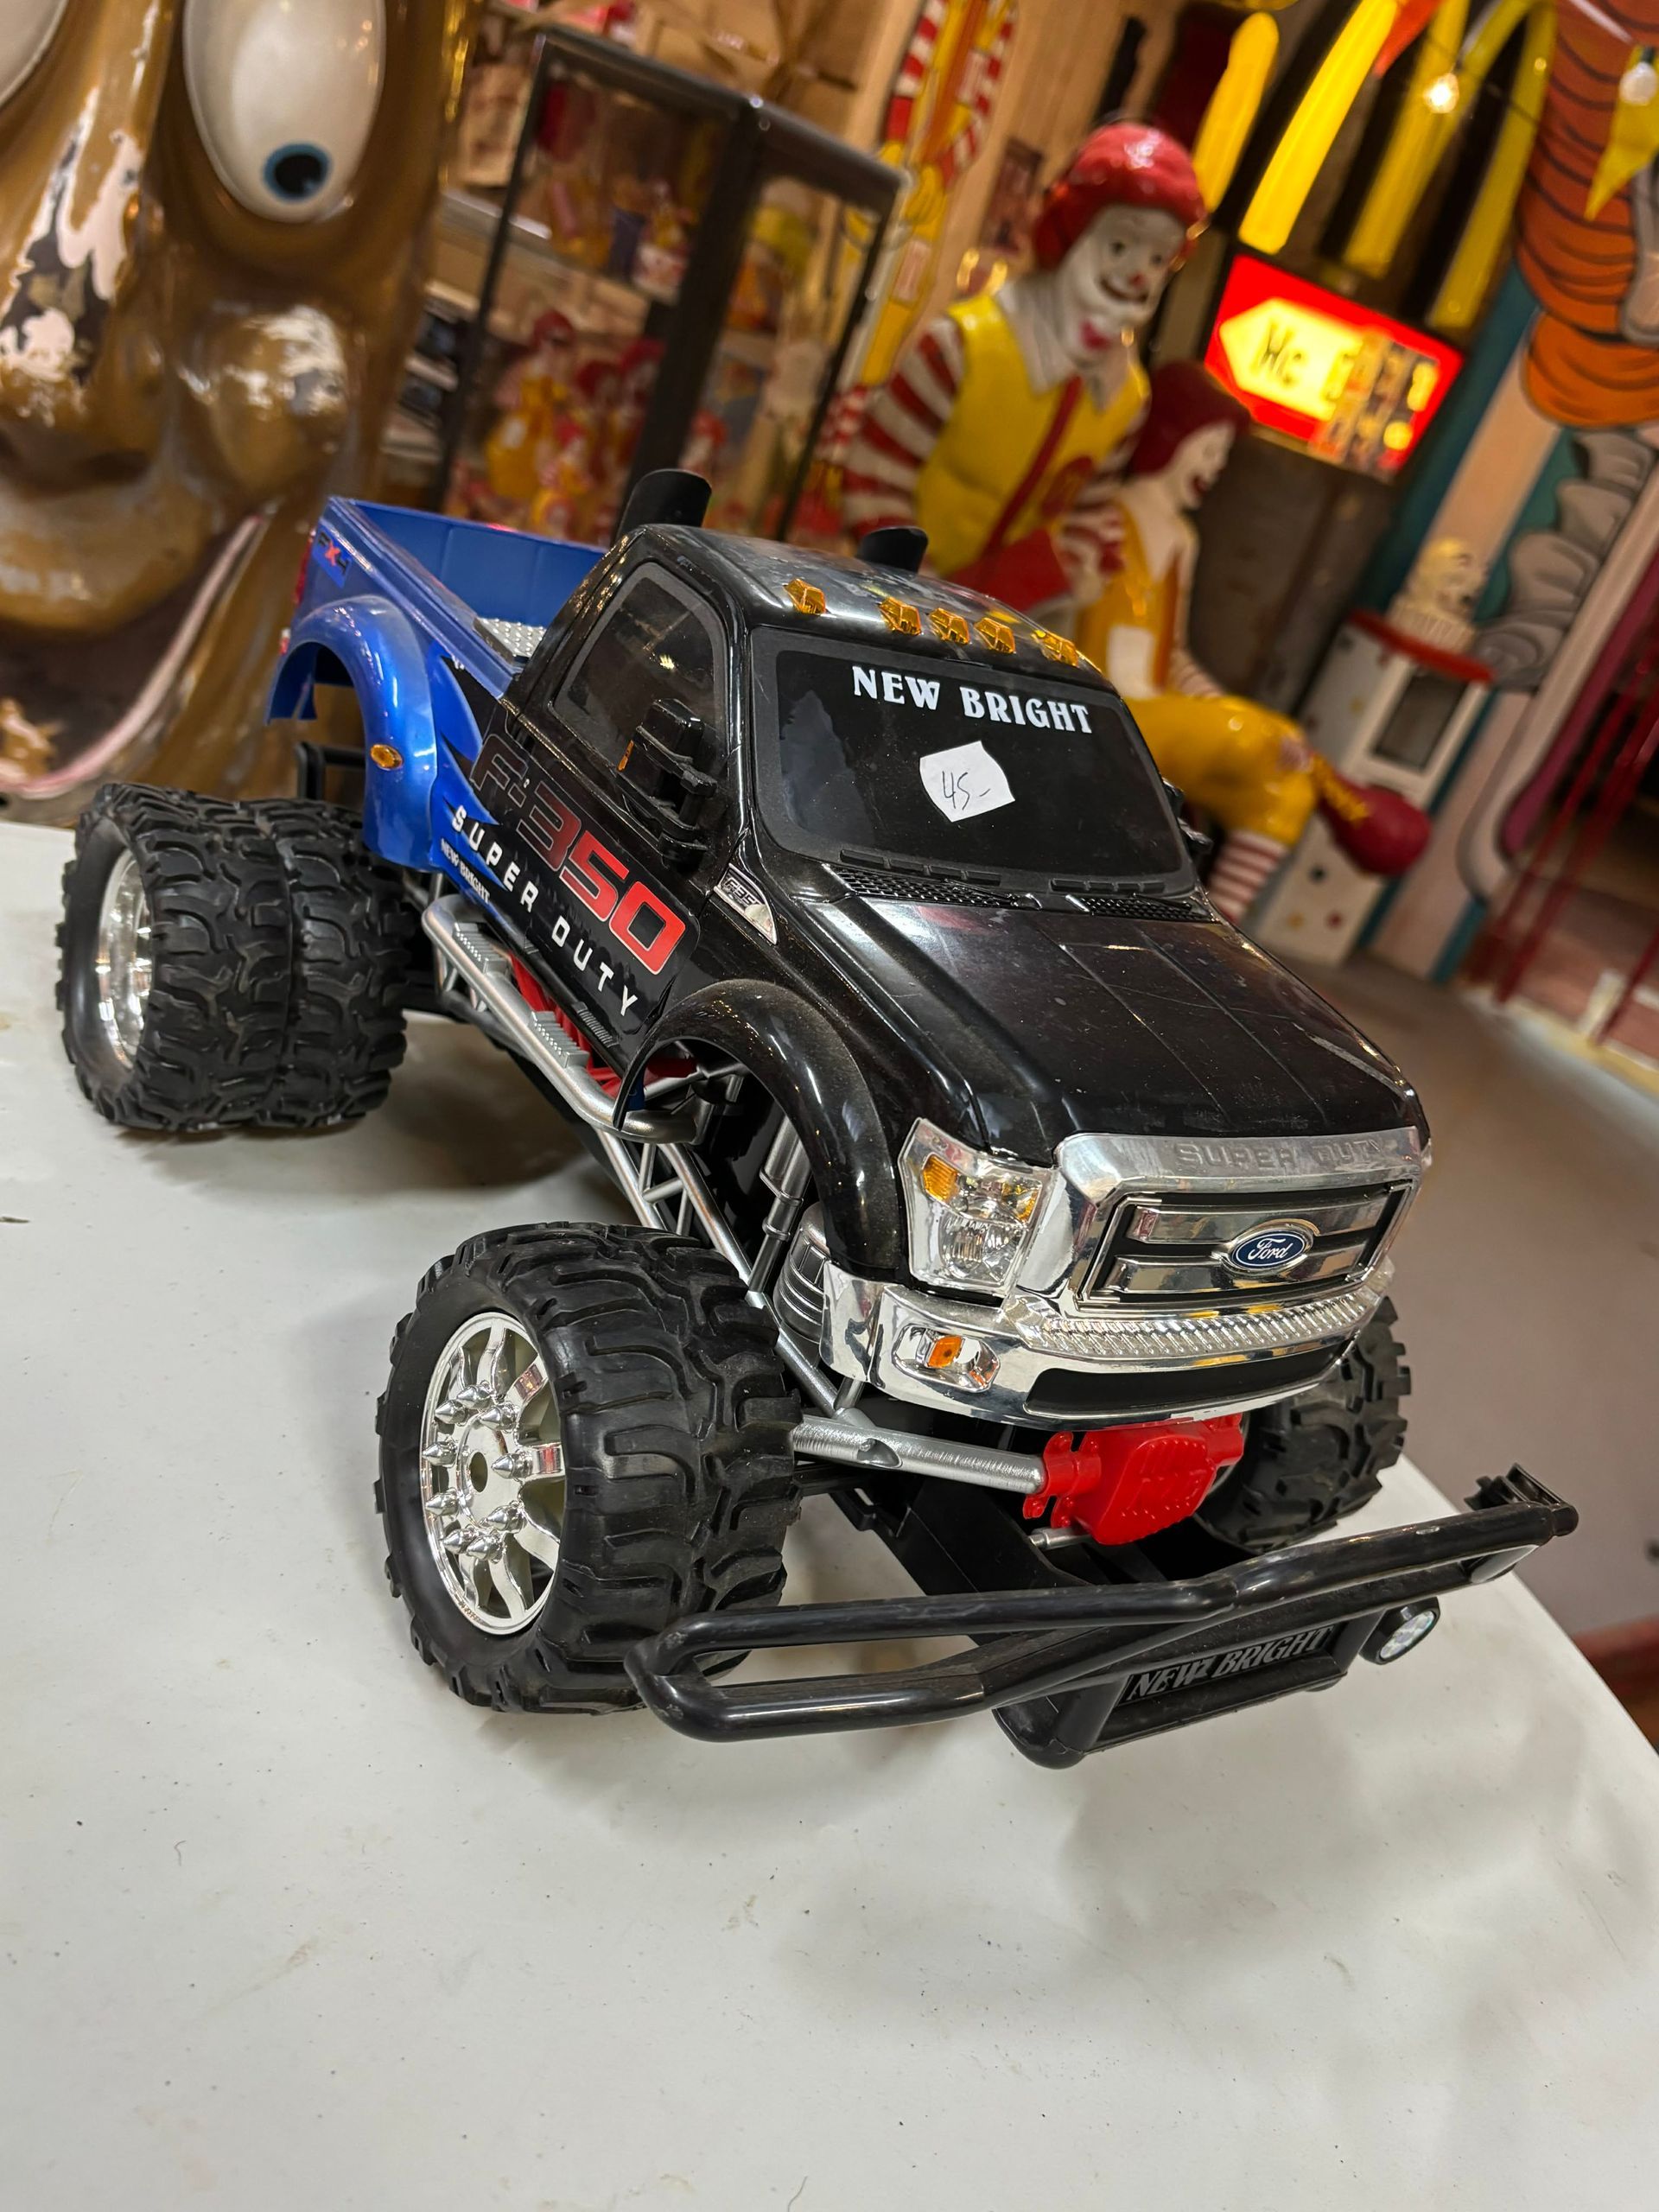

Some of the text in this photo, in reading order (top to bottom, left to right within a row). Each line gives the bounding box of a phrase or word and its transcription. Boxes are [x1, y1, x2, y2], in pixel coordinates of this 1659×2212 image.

[851, 665, 1092, 734] NEW BRIGHT
[450, 804, 638, 1016] SUPER DUTY
[460, 861, 491, 905] BRIGHT
[1173, 1139, 1382, 1169] SUPER DUTY
[1247, 1237, 1294, 1261] Ford
[1127, 1624, 1335, 1701] NEW BRIGHT
